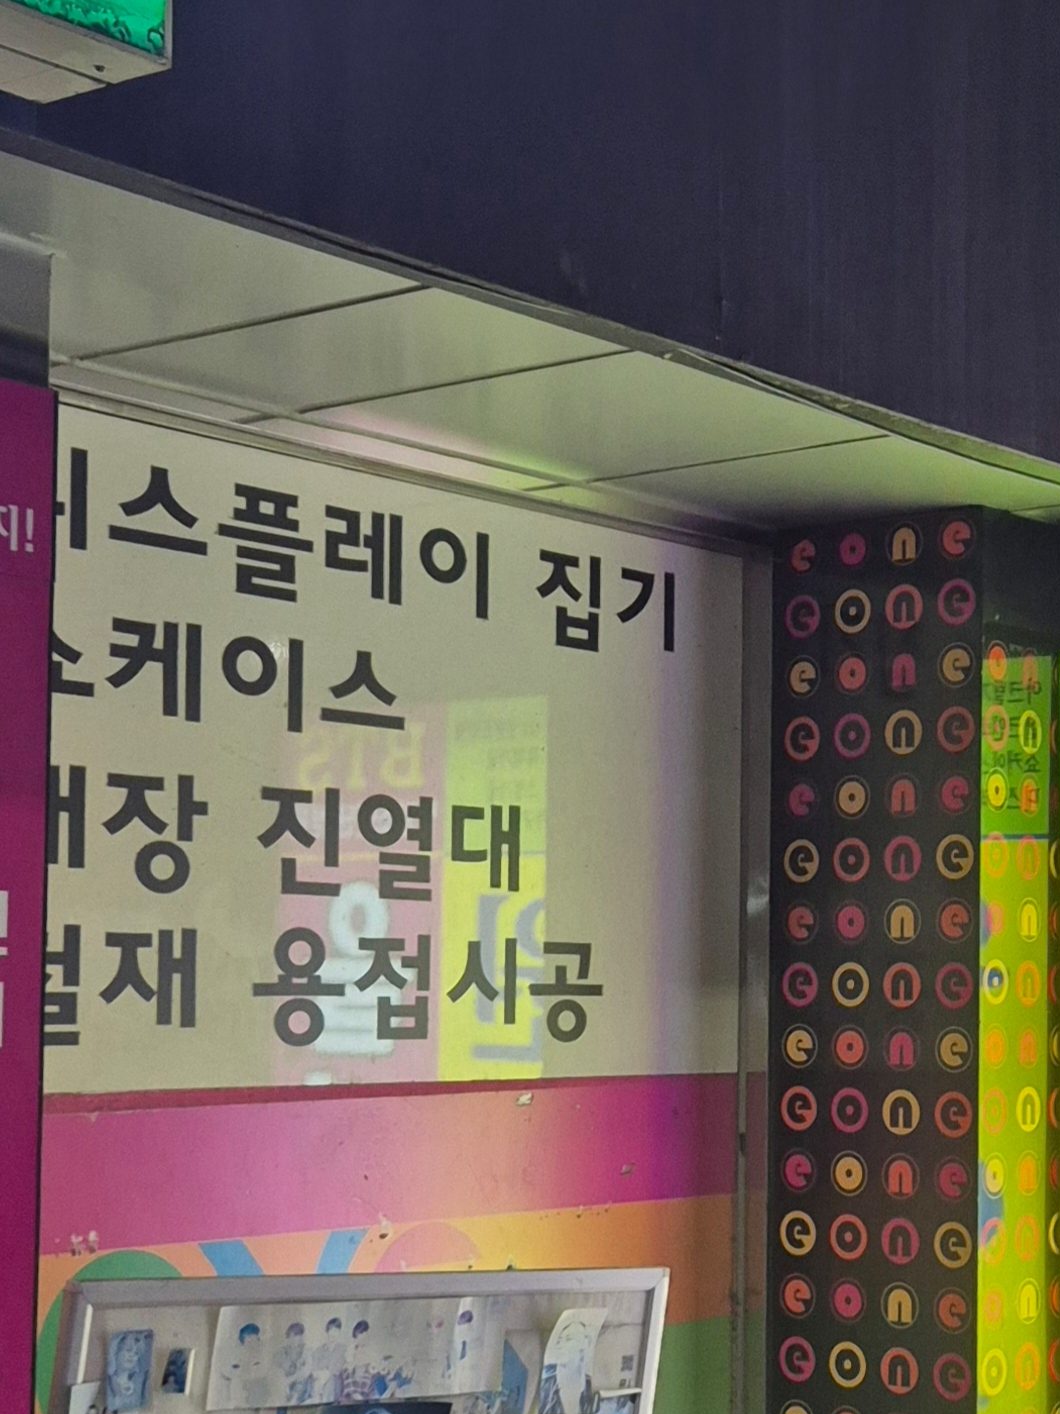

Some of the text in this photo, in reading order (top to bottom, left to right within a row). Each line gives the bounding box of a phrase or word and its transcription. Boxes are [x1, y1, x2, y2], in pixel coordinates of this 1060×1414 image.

[536, 548, 676, 652] 집기
[257, 785, 521, 901] 진열대
[251, 927, 604, 1046] 용접시공
